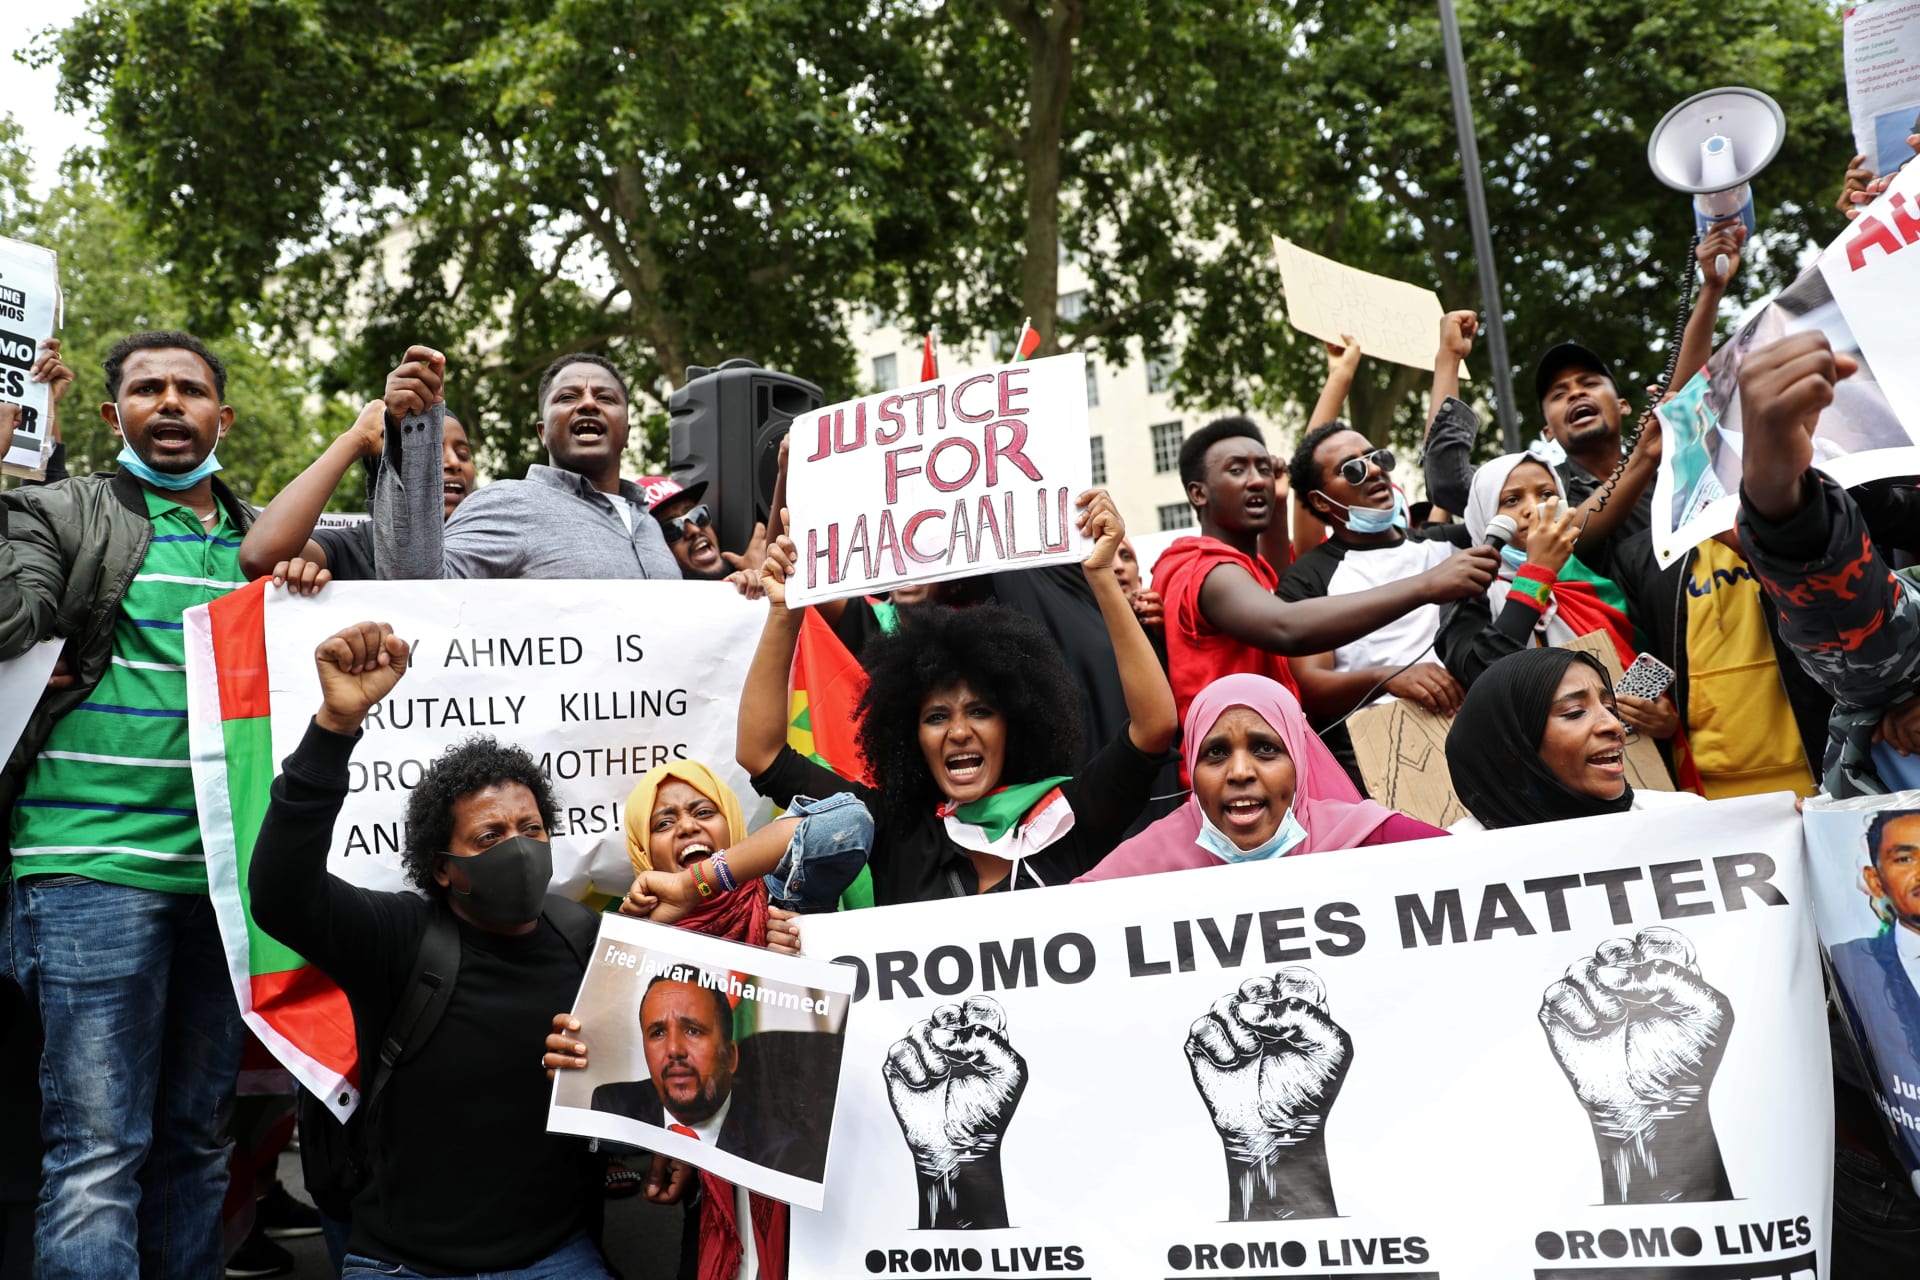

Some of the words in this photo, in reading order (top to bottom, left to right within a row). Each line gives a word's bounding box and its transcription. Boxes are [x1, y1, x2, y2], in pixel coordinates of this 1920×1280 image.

[807, 368, 1030, 462] JUSTICE
[885, 419, 1044, 505] FOR
[320, 518, 353, 527] haalu
[807, 487, 1070, 589] HAACAALU
[443, 636, 584, 668] AHMED
[616, 633, 645, 663] IS
[364, 695, 527, 731] RUTALLY
[560, 688, 688, 722] KILLING
[347, 758, 440, 793] ORO
[343, 821, 411, 858] AN
[549, 802, 620, 838] ERS!
[1125, 900, 1368, 978] LIVES
[1394, 851, 1791, 949] MATTER
[604, 944, 636, 969] Free
[636, 953, 694, 985] Jawar
[698, 969, 830, 1016] Mohammed
[864, 1248, 984, 1274] OROMO
[991, 1245, 1086, 1273] LIVES
[1166, 1240, 1308, 1271] OROMO
[1319, 1236, 1431, 1267] LIVES
[1535, 1226, 1703, 1261] OROMO
[1714, 1215, 1812, 1256] LIVES
